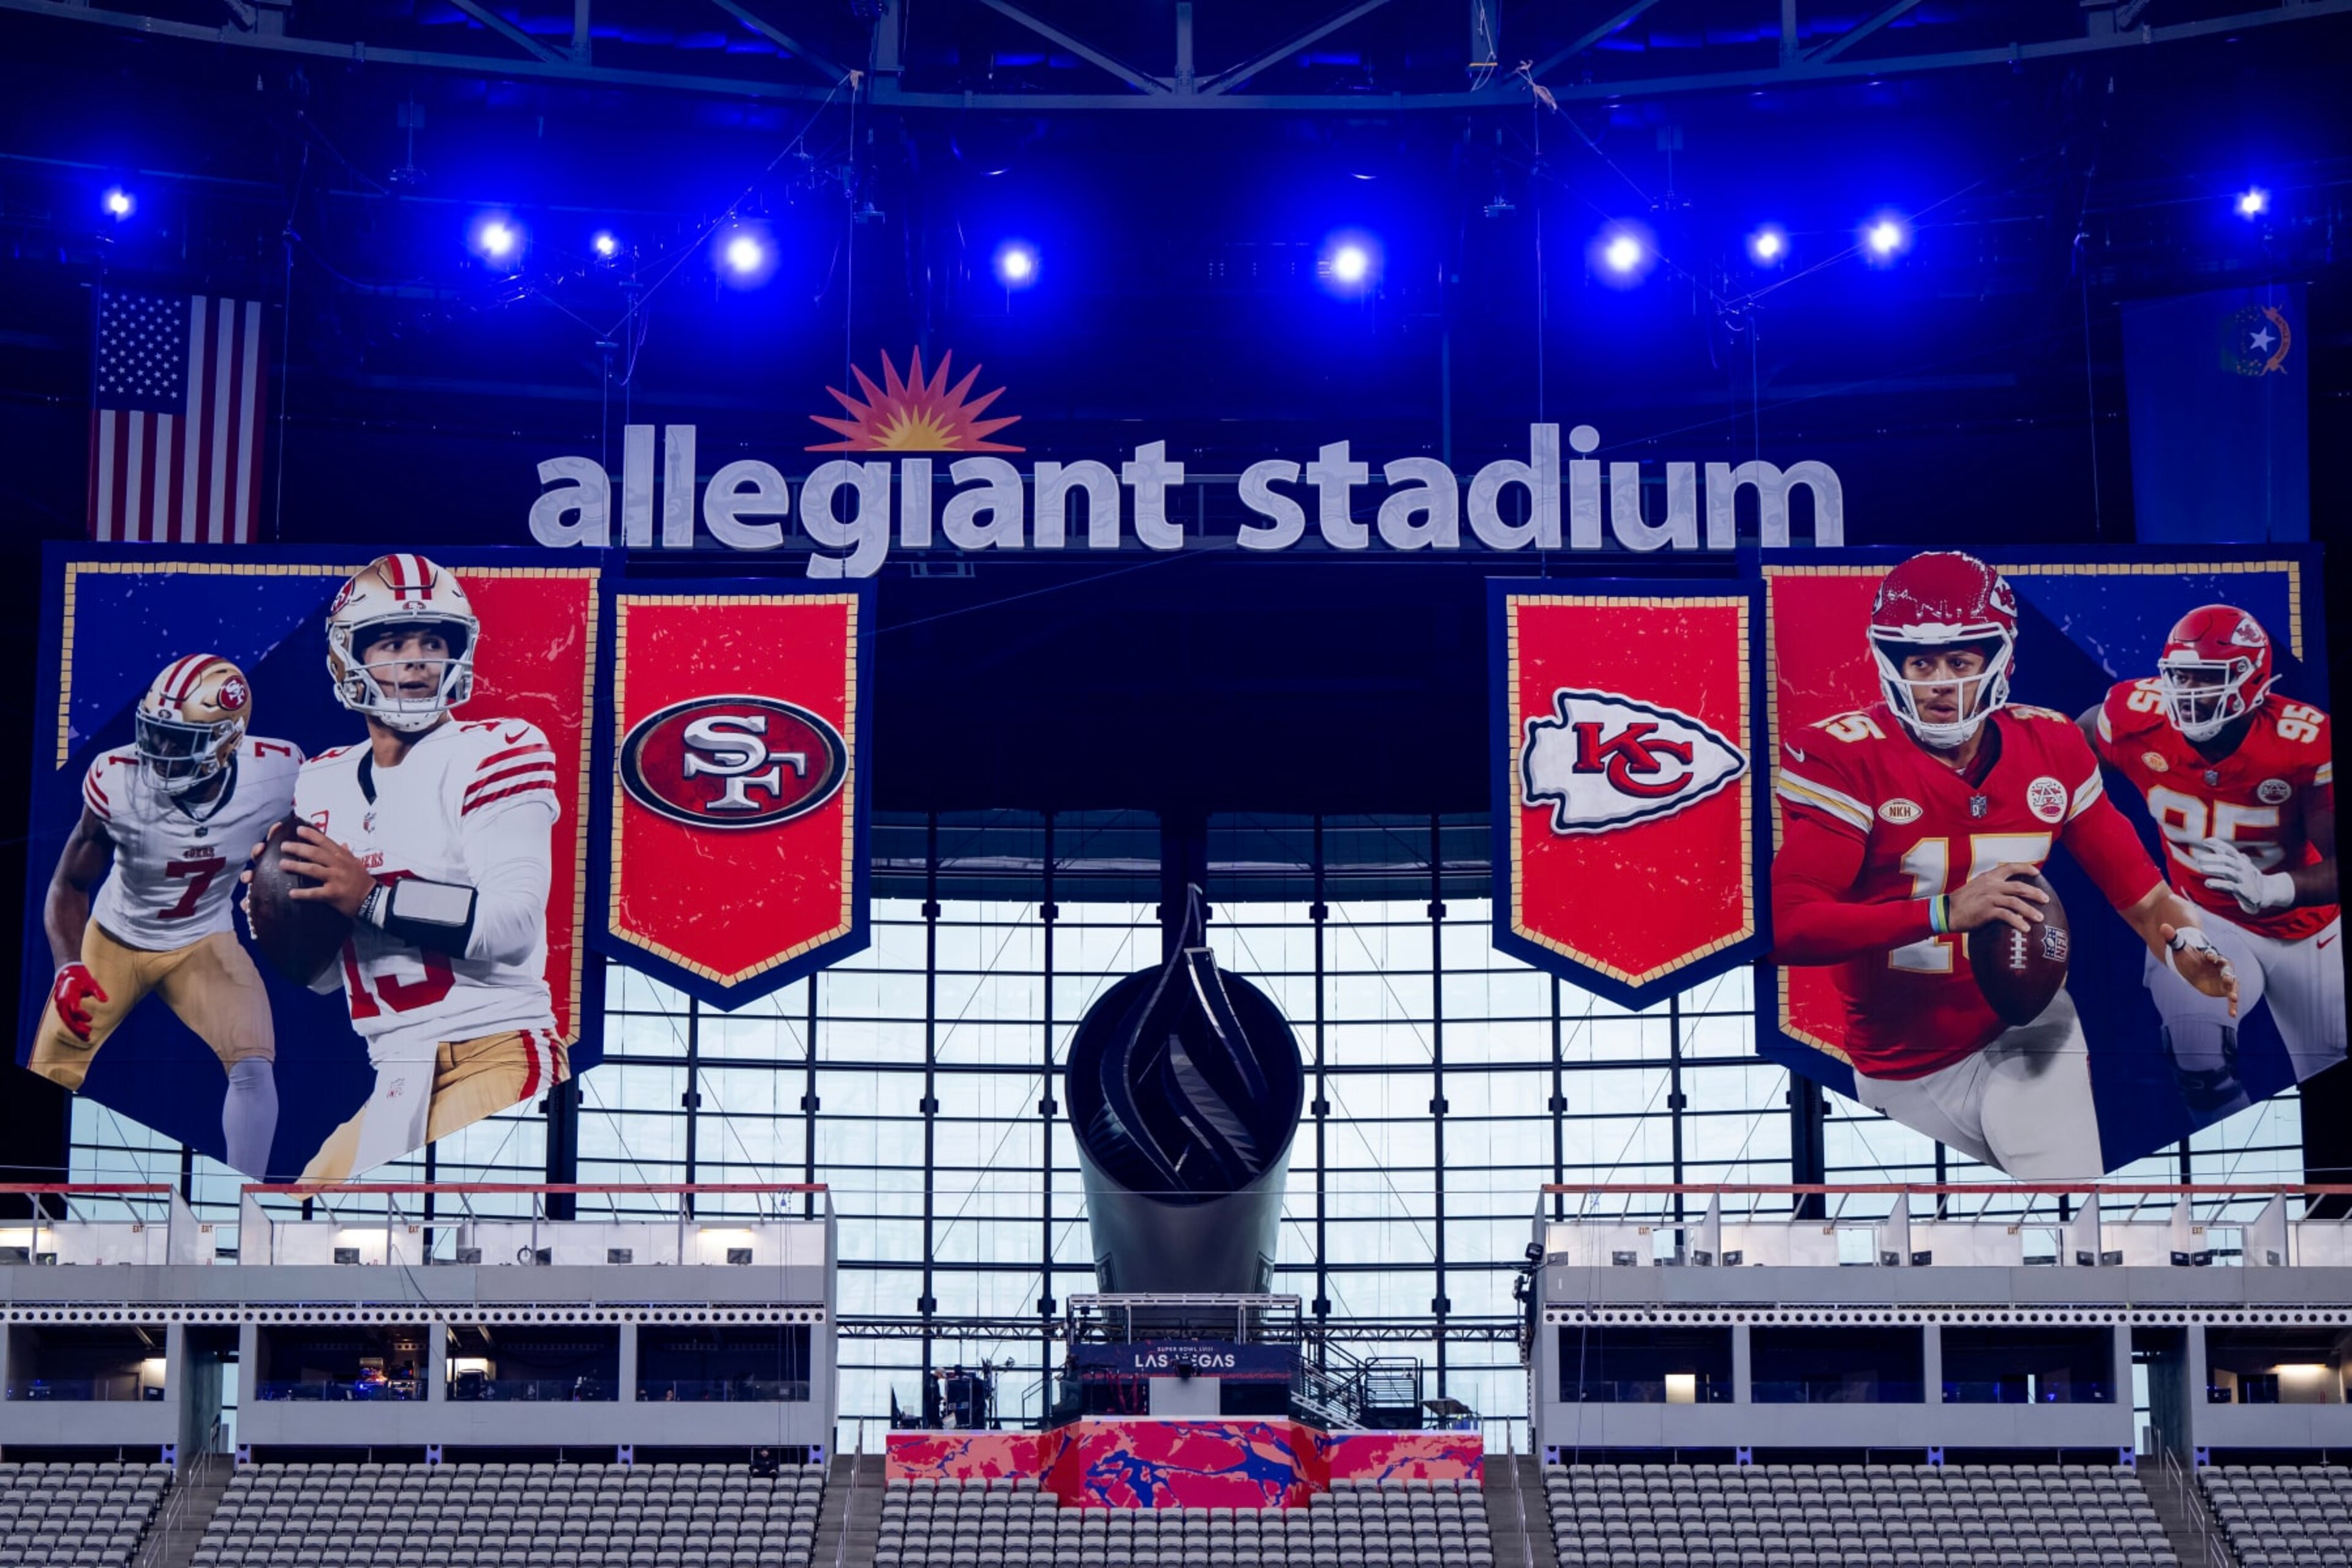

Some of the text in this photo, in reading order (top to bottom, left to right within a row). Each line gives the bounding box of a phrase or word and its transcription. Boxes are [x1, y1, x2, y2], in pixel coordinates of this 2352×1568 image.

[529, 423, 1844, 579] allegiant stadium
[2277, 704, 2325, 743] 95
[254, 742, 291, 757] 7
[683, 715, 806, 809] SF
[1572, 722, 1694, 797] KC
[1890, 806, 1910, 817] NKH
[2147, 785, 2285, 875] 95
[360, 851, 383, 868] ERS
[157, 857, 226, 919] 7
[1135, 1354, 1235, 1368] LAS EGAS
